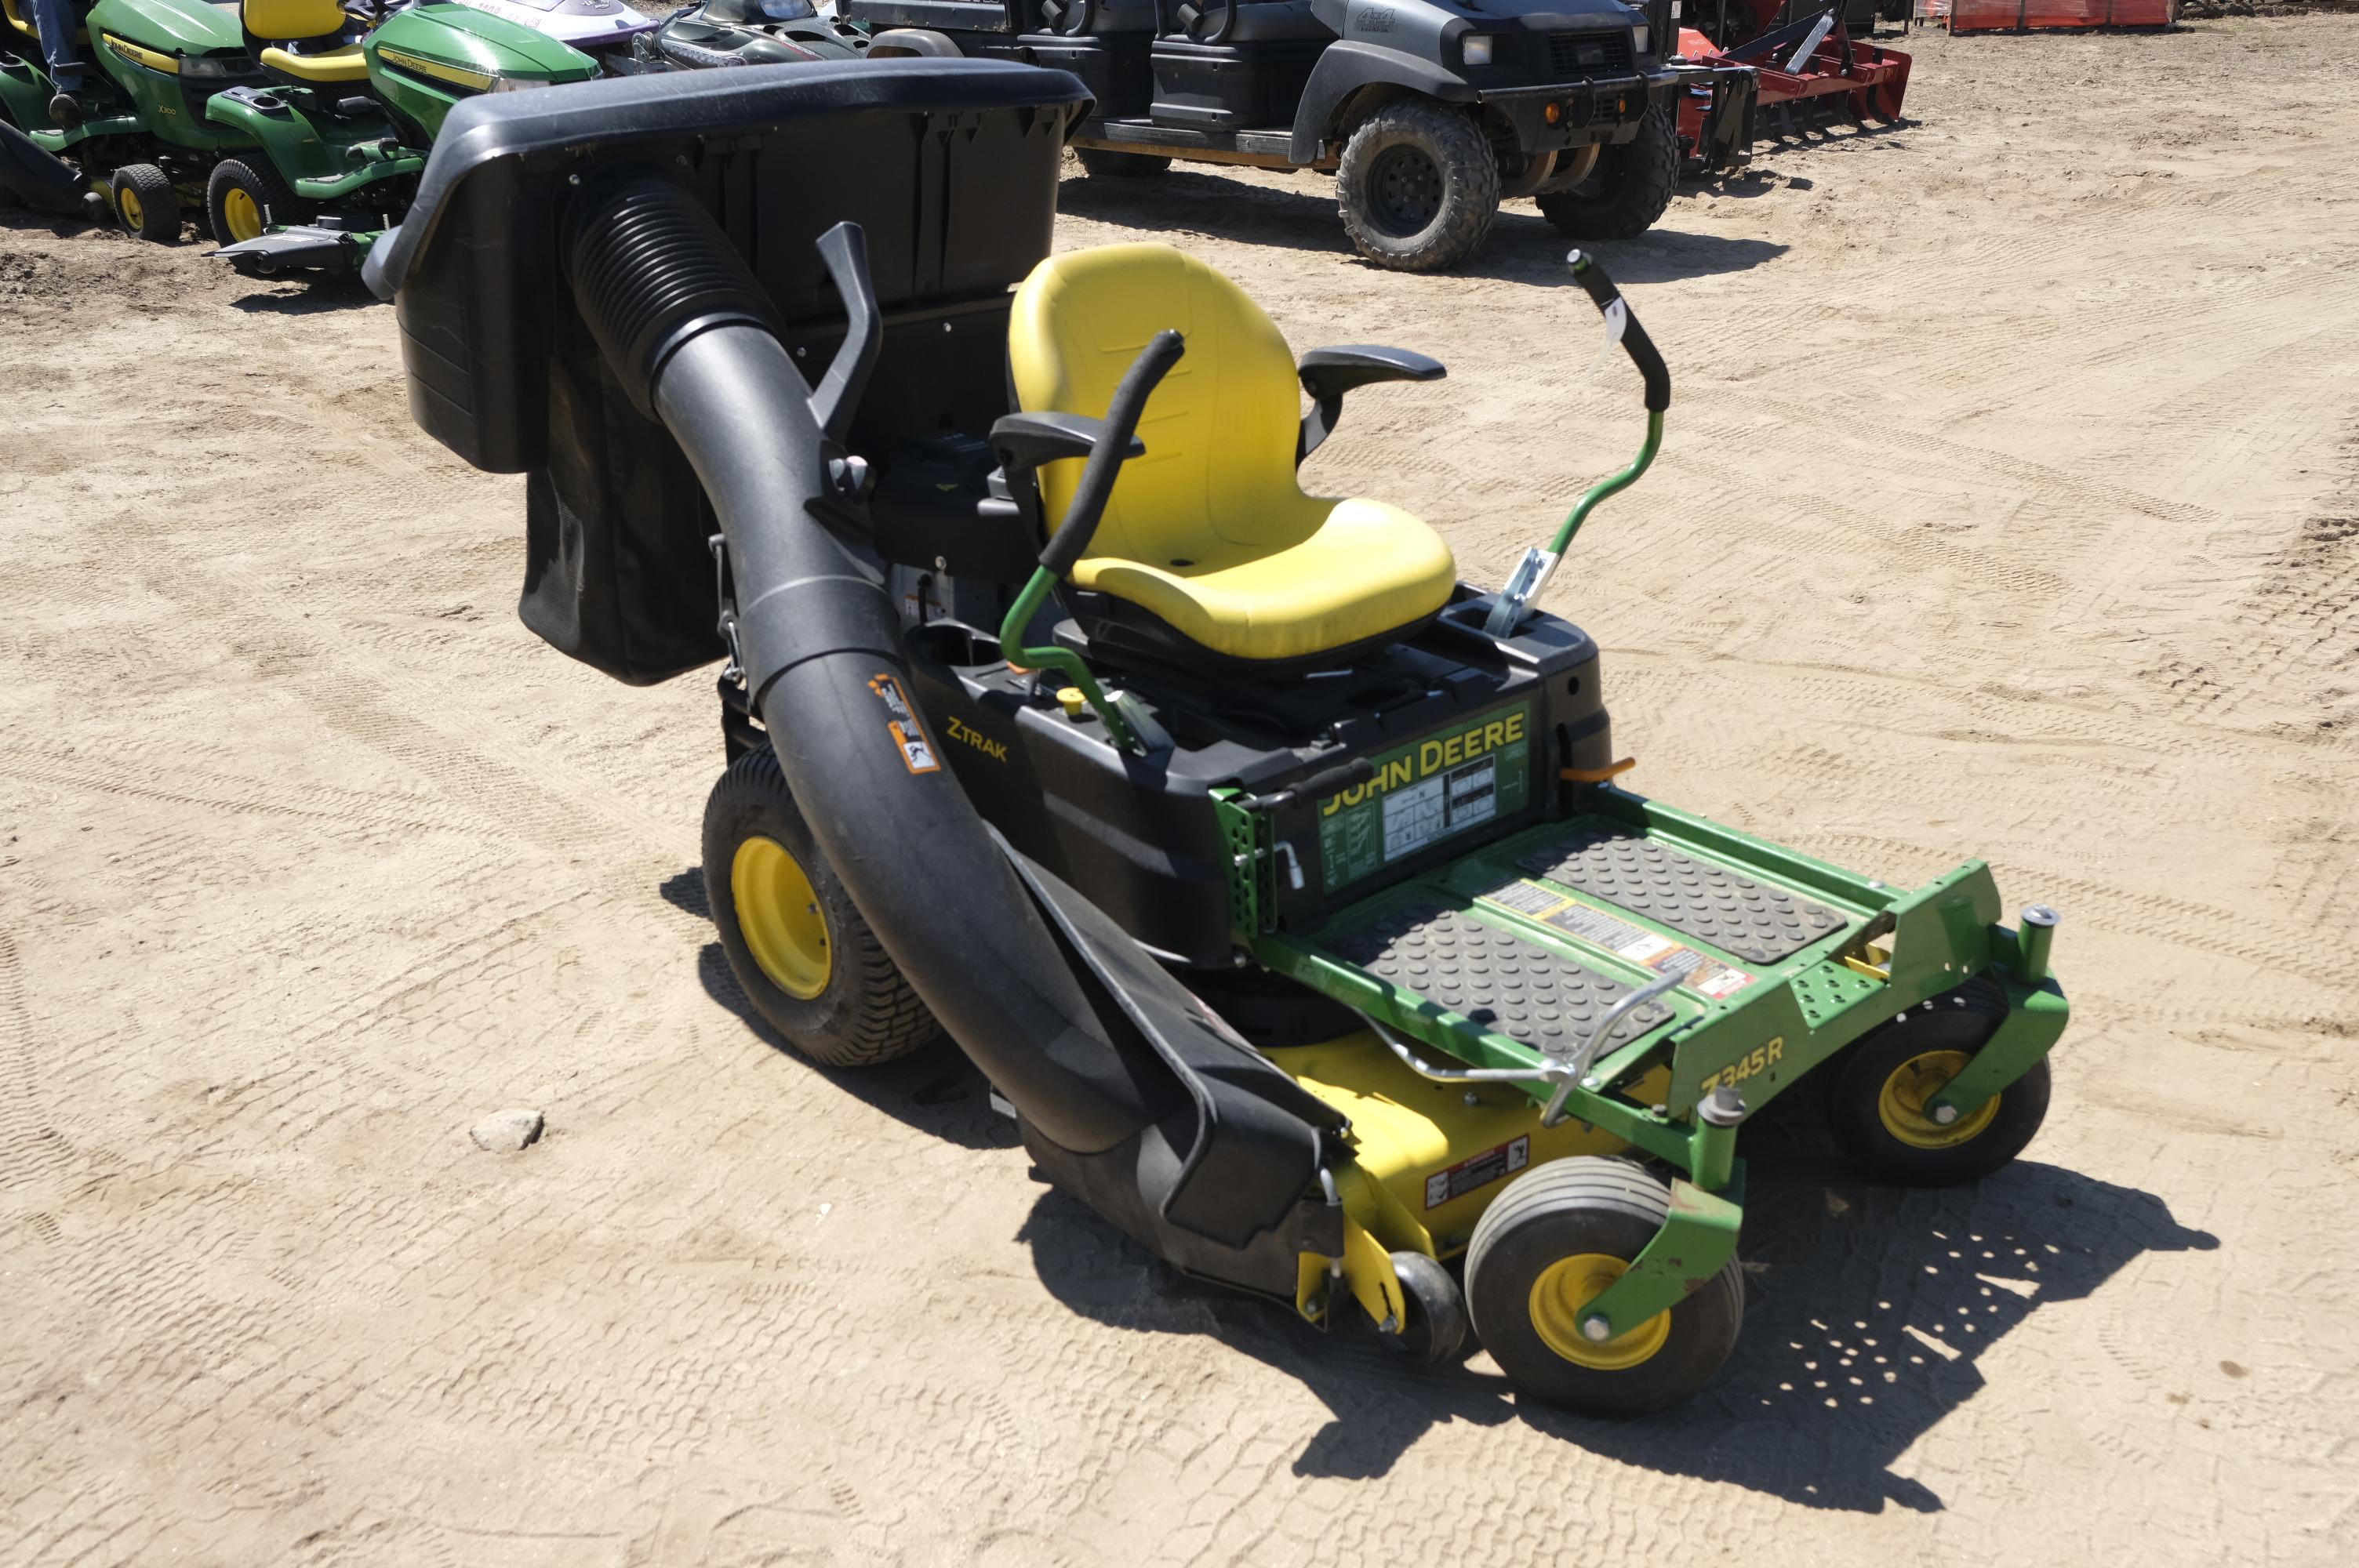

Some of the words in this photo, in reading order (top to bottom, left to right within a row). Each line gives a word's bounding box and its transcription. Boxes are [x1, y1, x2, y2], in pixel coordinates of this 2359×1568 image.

[392, 53, 408, 67] JOHN
[407, 59, 428, 74] DEERE
[947, 716, 1009, 763] ZTRAK
[1420, 712, 1525, 776] DEERE
